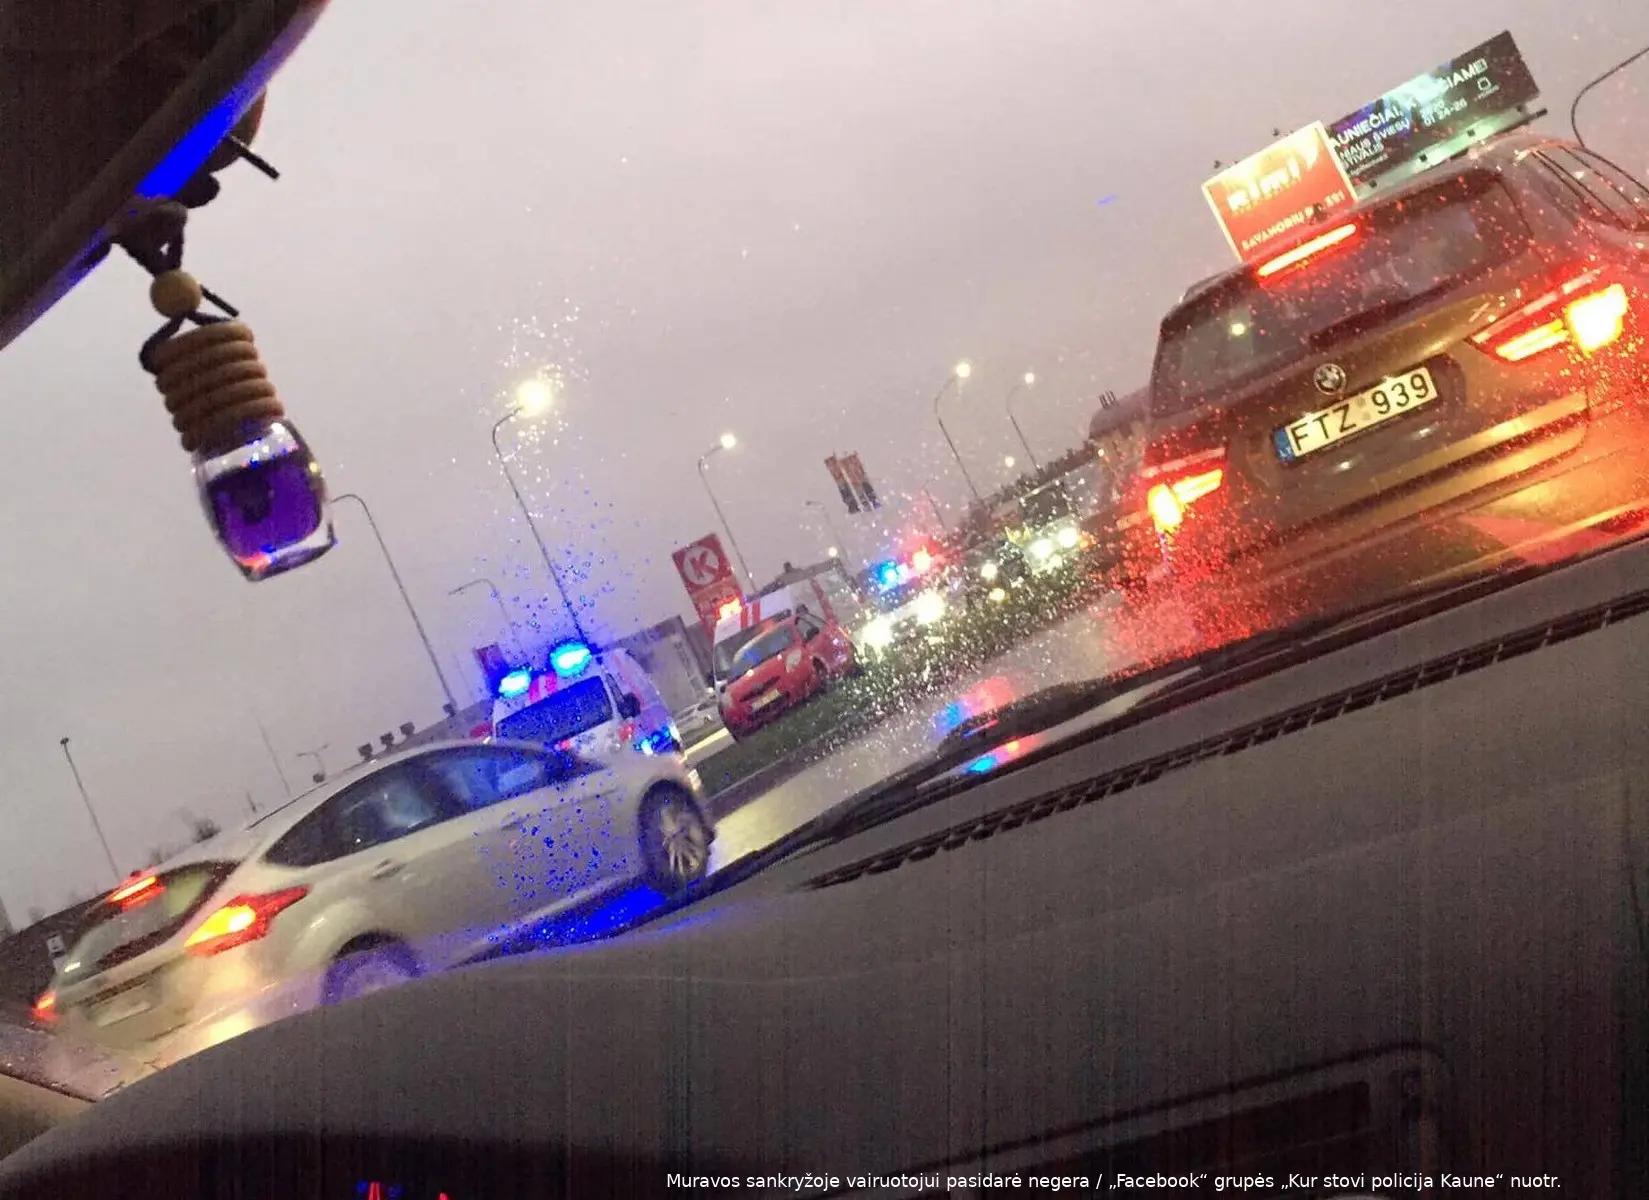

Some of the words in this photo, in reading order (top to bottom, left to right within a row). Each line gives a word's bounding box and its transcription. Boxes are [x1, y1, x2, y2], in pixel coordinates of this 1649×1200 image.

[1331, 105, 1403, 148] AUNIEČIAI,
[1290, 404, 1357, 451] FTZ
[1371, 373, 1430, 415] 939
[688, 548, 714, 578] K
